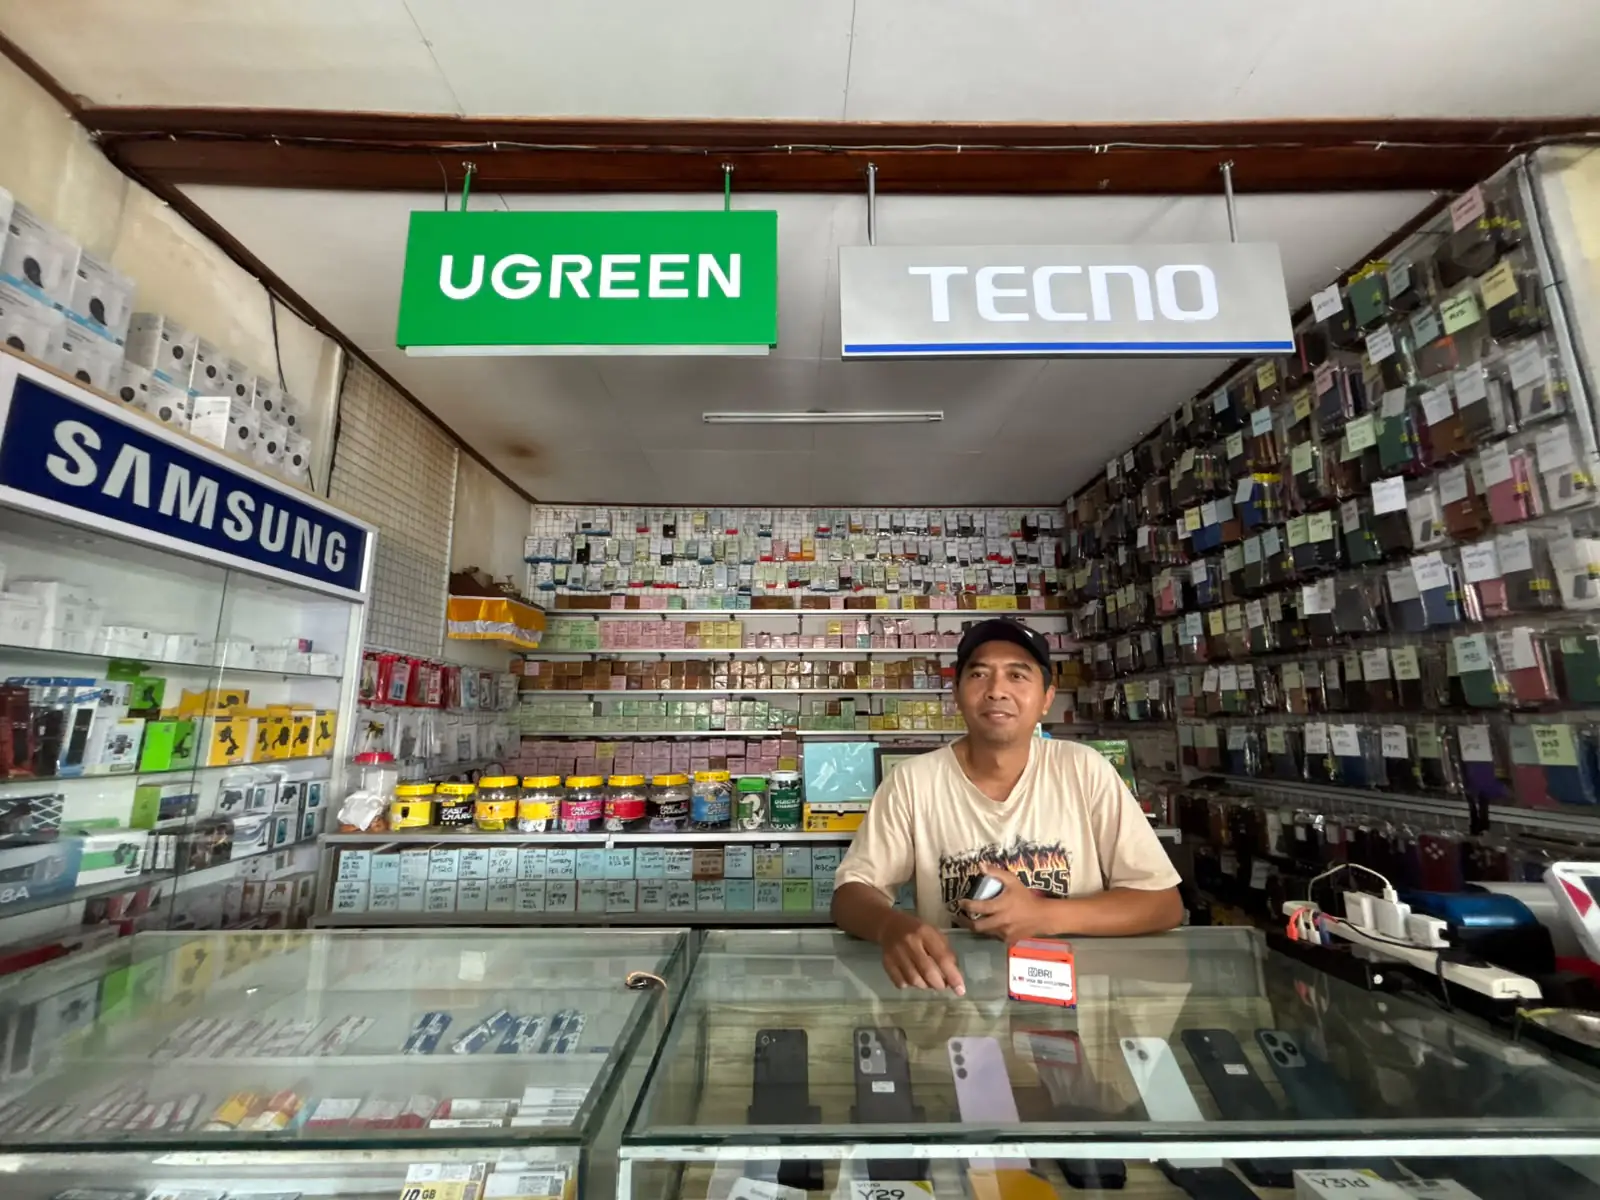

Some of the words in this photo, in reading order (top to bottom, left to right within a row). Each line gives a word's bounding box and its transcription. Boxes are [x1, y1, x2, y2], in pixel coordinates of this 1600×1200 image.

[439, 253, 741, 300] UGREEN
[908, 263, 1220, 323] TECNO
[46, 419, 348, 573] SAMSUNG
[442, 806, 463, 815] FAST
[421, 1188, 438, 1200] GB
